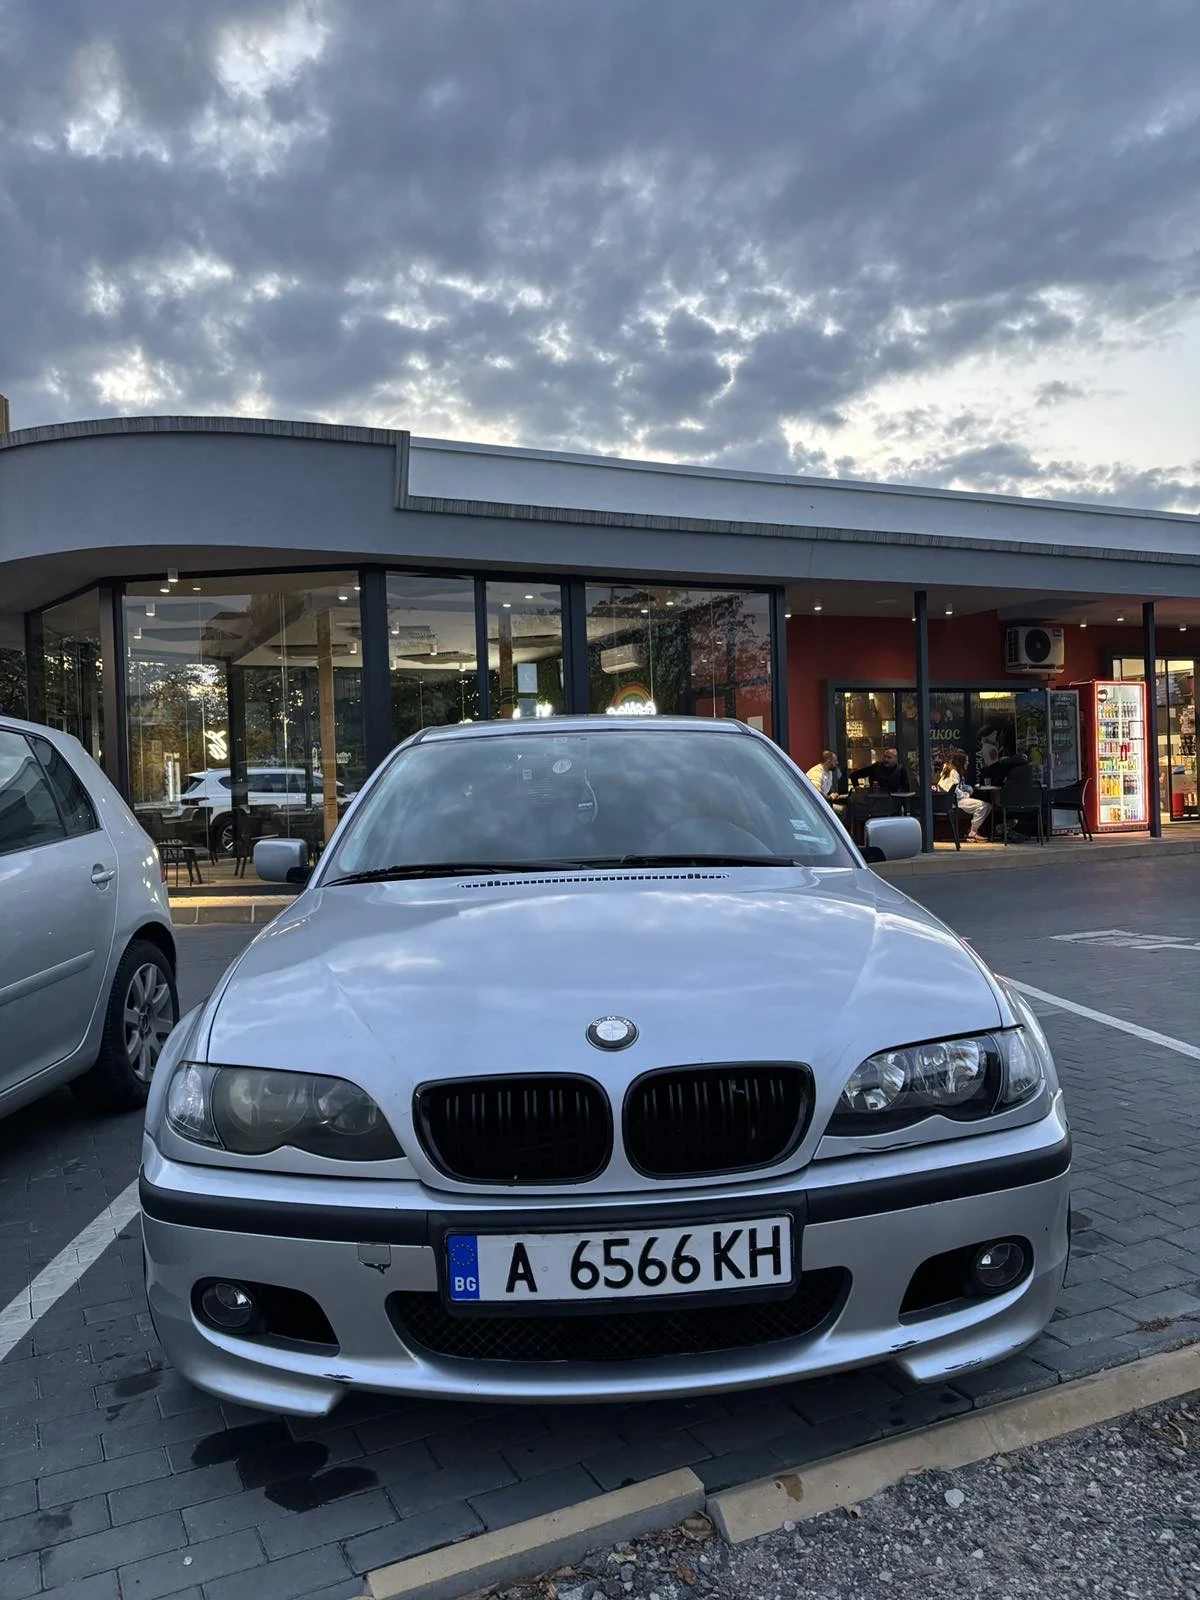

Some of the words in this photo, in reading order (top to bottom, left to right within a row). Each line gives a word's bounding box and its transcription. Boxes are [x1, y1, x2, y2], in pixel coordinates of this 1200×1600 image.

[505, 1242, 538, 1293] A
[570, 1234, 701, 1290] 6566
[713, 1225, 781, 1281] KH
[454, 1277, 477, 1292] BG
